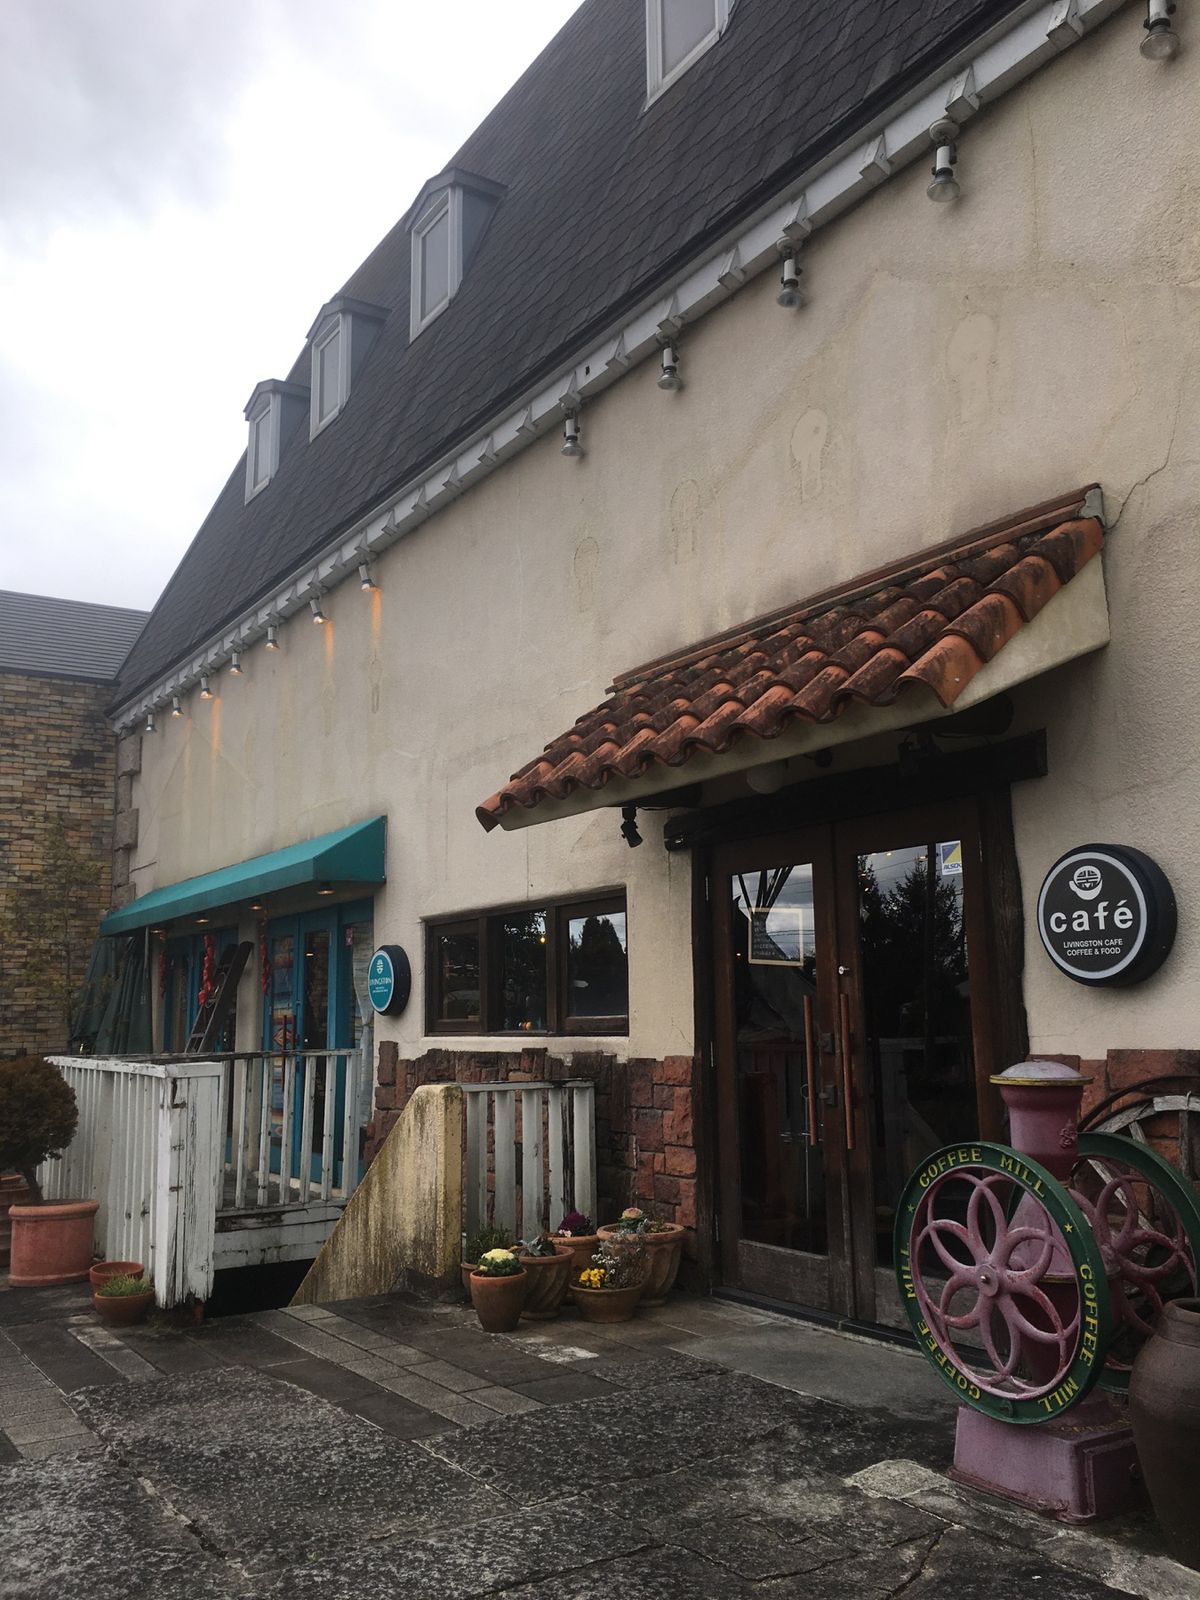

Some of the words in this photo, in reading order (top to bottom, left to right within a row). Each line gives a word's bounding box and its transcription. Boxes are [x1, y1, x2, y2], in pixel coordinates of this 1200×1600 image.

[1050, 899, 1133, 933] café
[1063, 940, 1103, 948] LIVINGSTON
[1104, 938, 1123, 946] CAFE
[1066, 948, 1093, 956] COFFEE
[1101, 947, 1121, 955] FOOD
[919, 1148, 983, 1188] COFFEE
[1000, 1154, 1046, 1199] MILL
[901, 1248, 917, 1298] MILL
[1080, 1263, 1099, 1367] COFFEE
[917, 1319, 981, 1400] COFFEE
[1038, 1377, 1080, 1413] MILL
